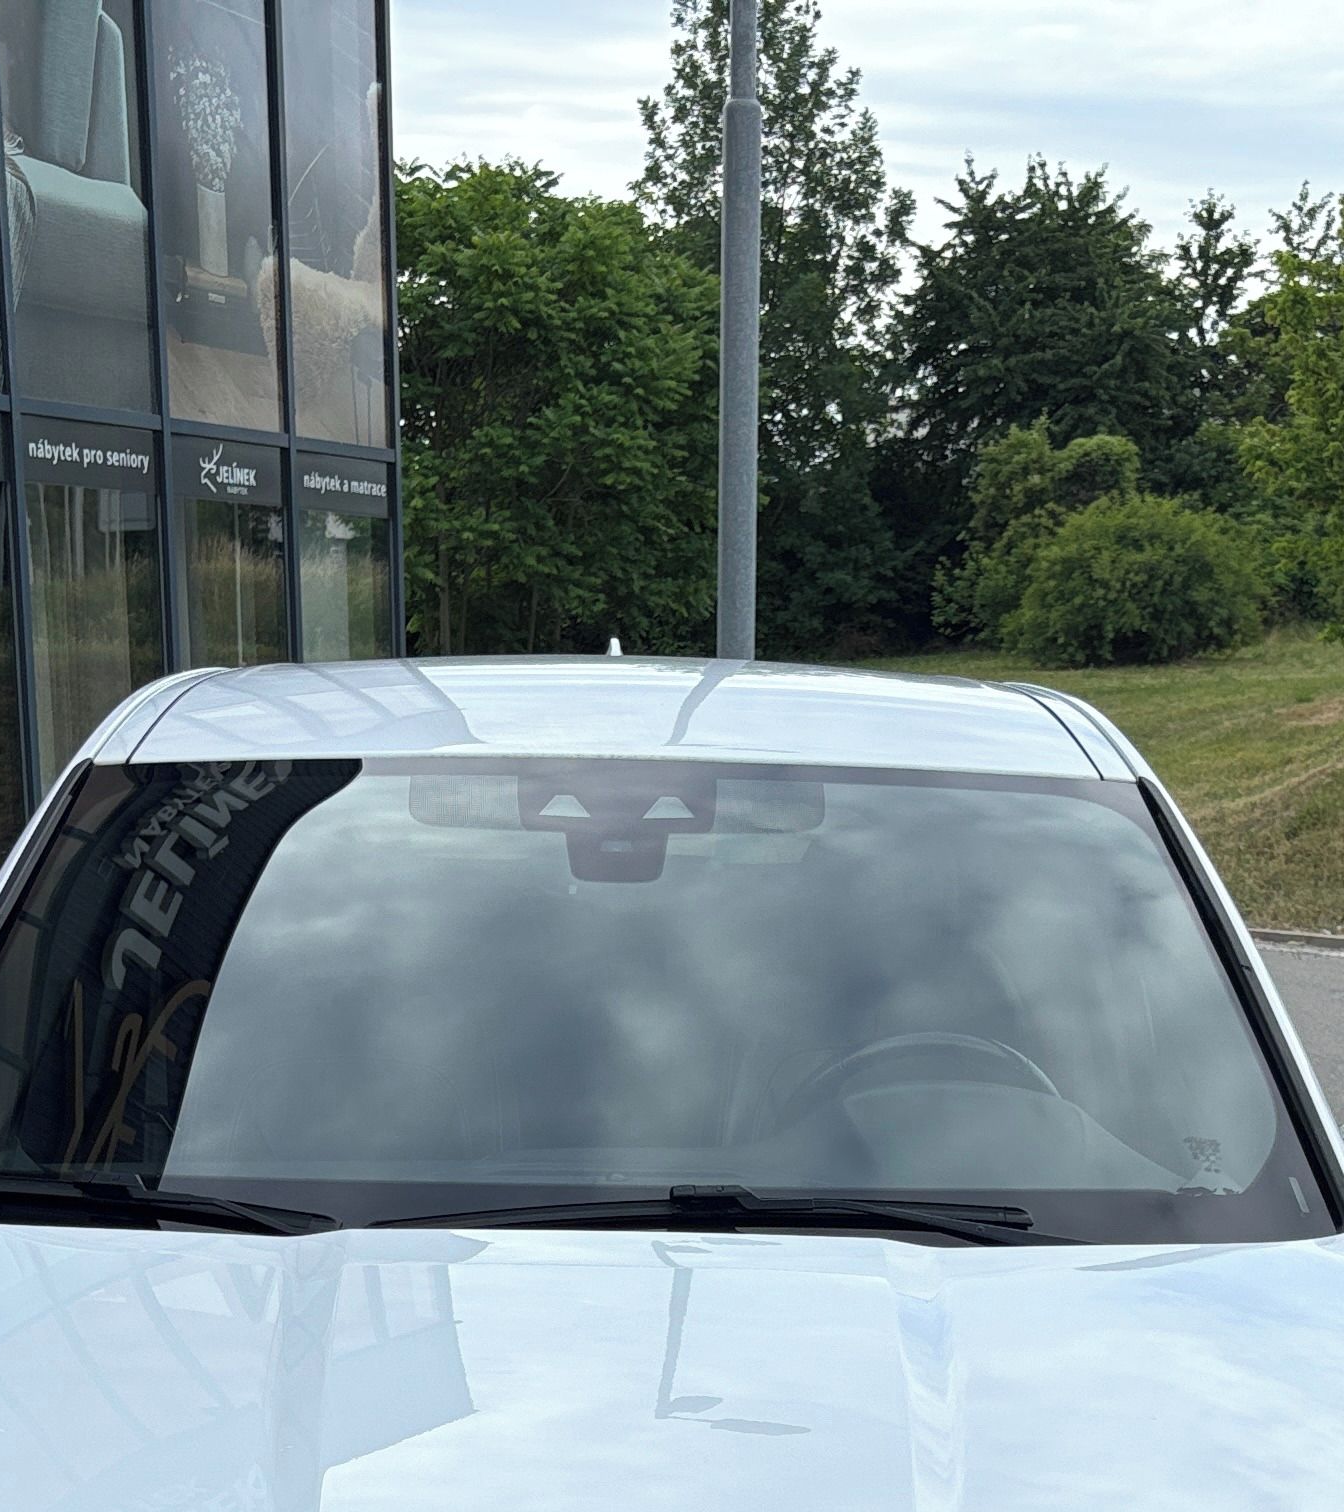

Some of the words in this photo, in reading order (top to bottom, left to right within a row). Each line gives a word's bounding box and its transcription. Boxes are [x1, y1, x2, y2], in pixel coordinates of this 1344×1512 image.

[28, 438, 80, 465] nábytek
[83, 449, 104, 469] pro
[106, 448, 150, 475] seniory
[216, 462, 257, 487] JELÍNEK
[303, 471, 341, 494] nábytek
[343, 480, 349, 493] a
[350, 481, 388, 497] matrace
